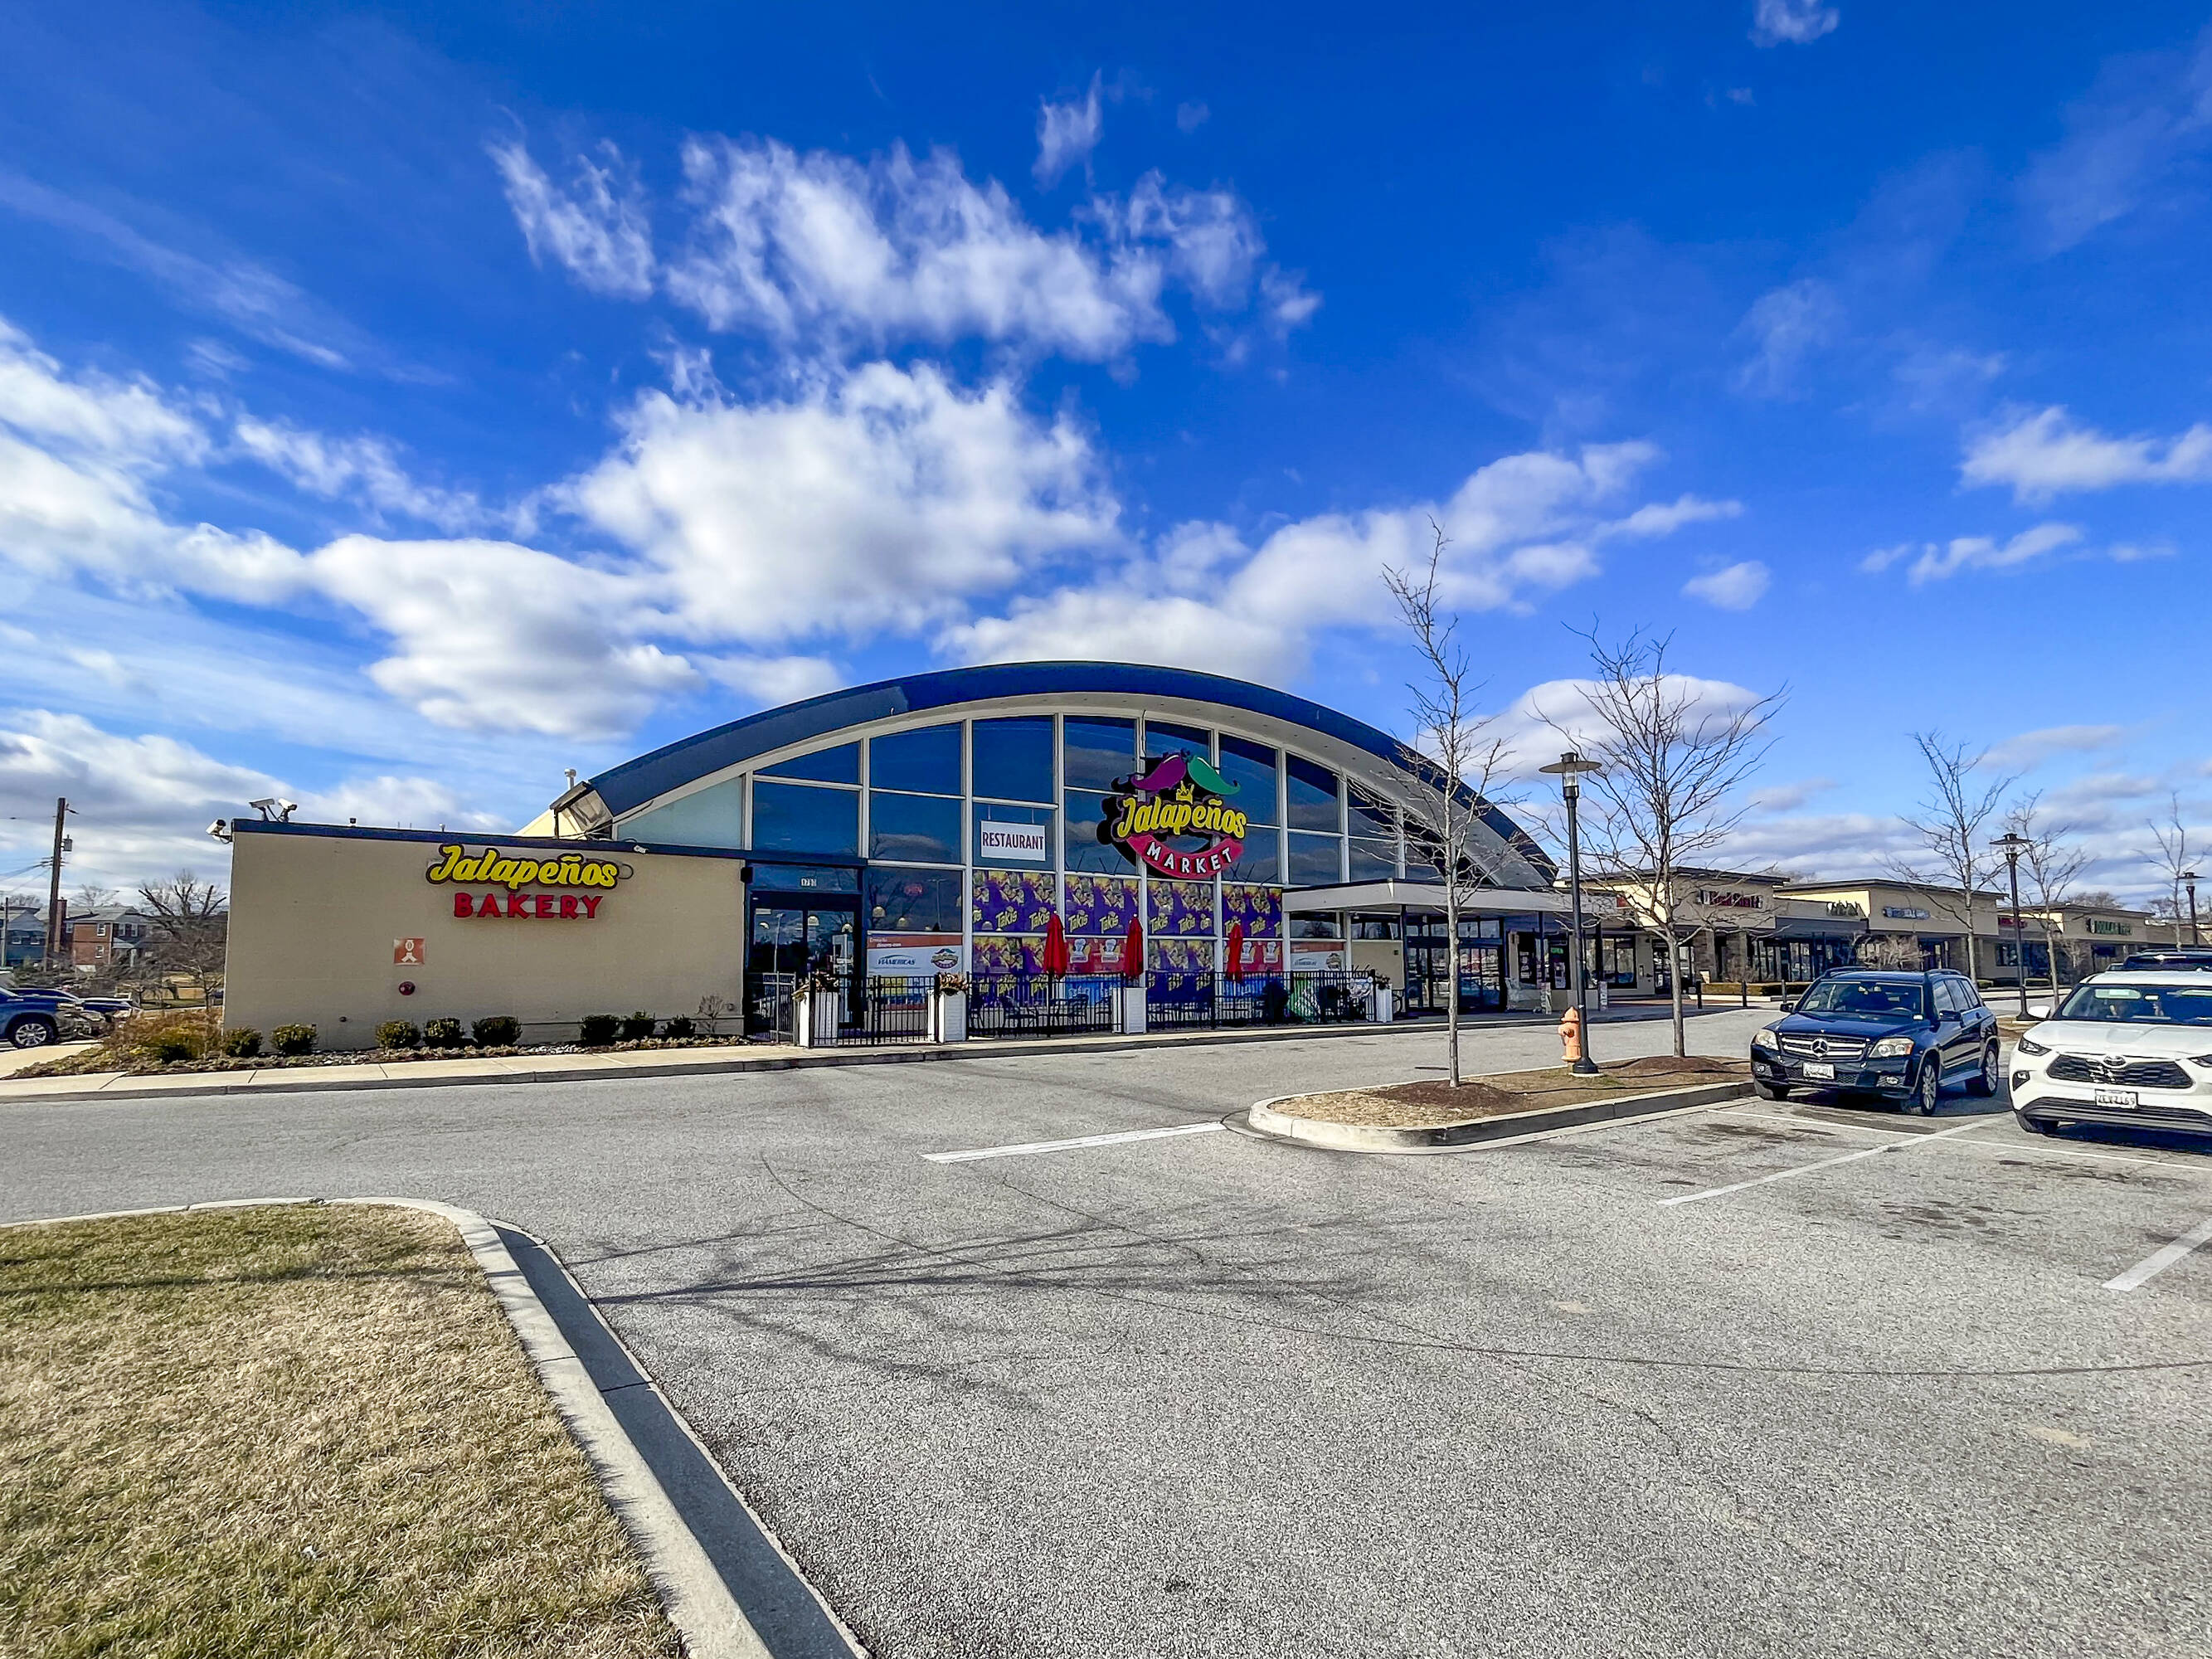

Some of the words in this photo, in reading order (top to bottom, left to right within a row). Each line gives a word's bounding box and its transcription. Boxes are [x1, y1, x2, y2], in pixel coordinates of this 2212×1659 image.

[1117, 795, 1247, 839] Jalapeños
[982, 832, 1044, 850] RESTAURANT
[1146, 841, 1232, 873] MARKET
[428, 844, 619, 890] Jalapeños
[454, 892, 603, 919] BAKERY
[995, 910, 1018, 929] Takis
[1028, 911, 1050, 930] Takis
[1068, 913, 1089, 932] Takis
[1099, 915, 1119, 934] Takis
[1150, 916, 1169, 934] Takis
[1178, 917, 1196, 935] Takis
